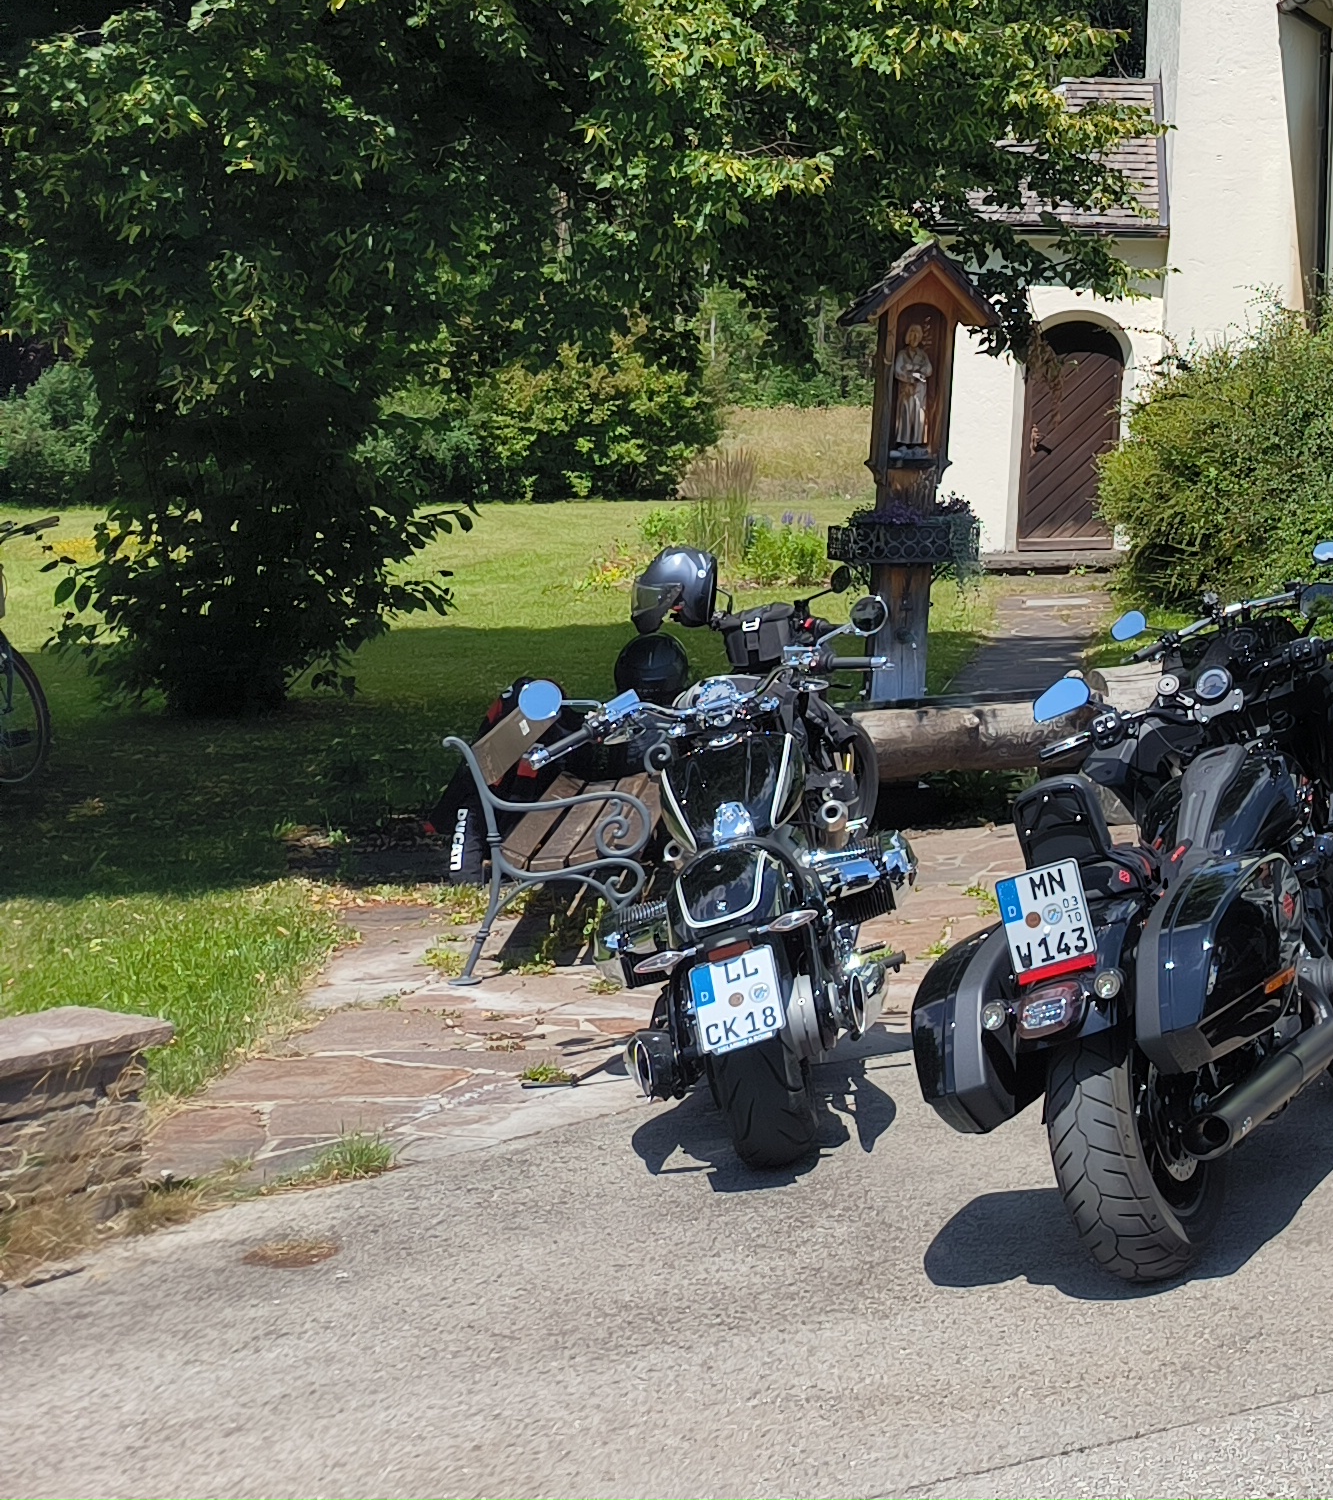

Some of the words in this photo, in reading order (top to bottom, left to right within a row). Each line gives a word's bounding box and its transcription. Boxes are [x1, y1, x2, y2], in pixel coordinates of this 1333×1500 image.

[449, 808, 469, 871] DUCATI
[1028, 868, 1066, 901] MN
[1062, 895, 1079, 909] 03
[1067, 911, 1082, 924] 10
[1015, 941, 1033, 969] W
[1037, 926, 1088, 963] 143
[724, 957, 759, 984] LL
[705, 1016, 741, 1046] CK
[745, 1006, 777, 1034] 18
